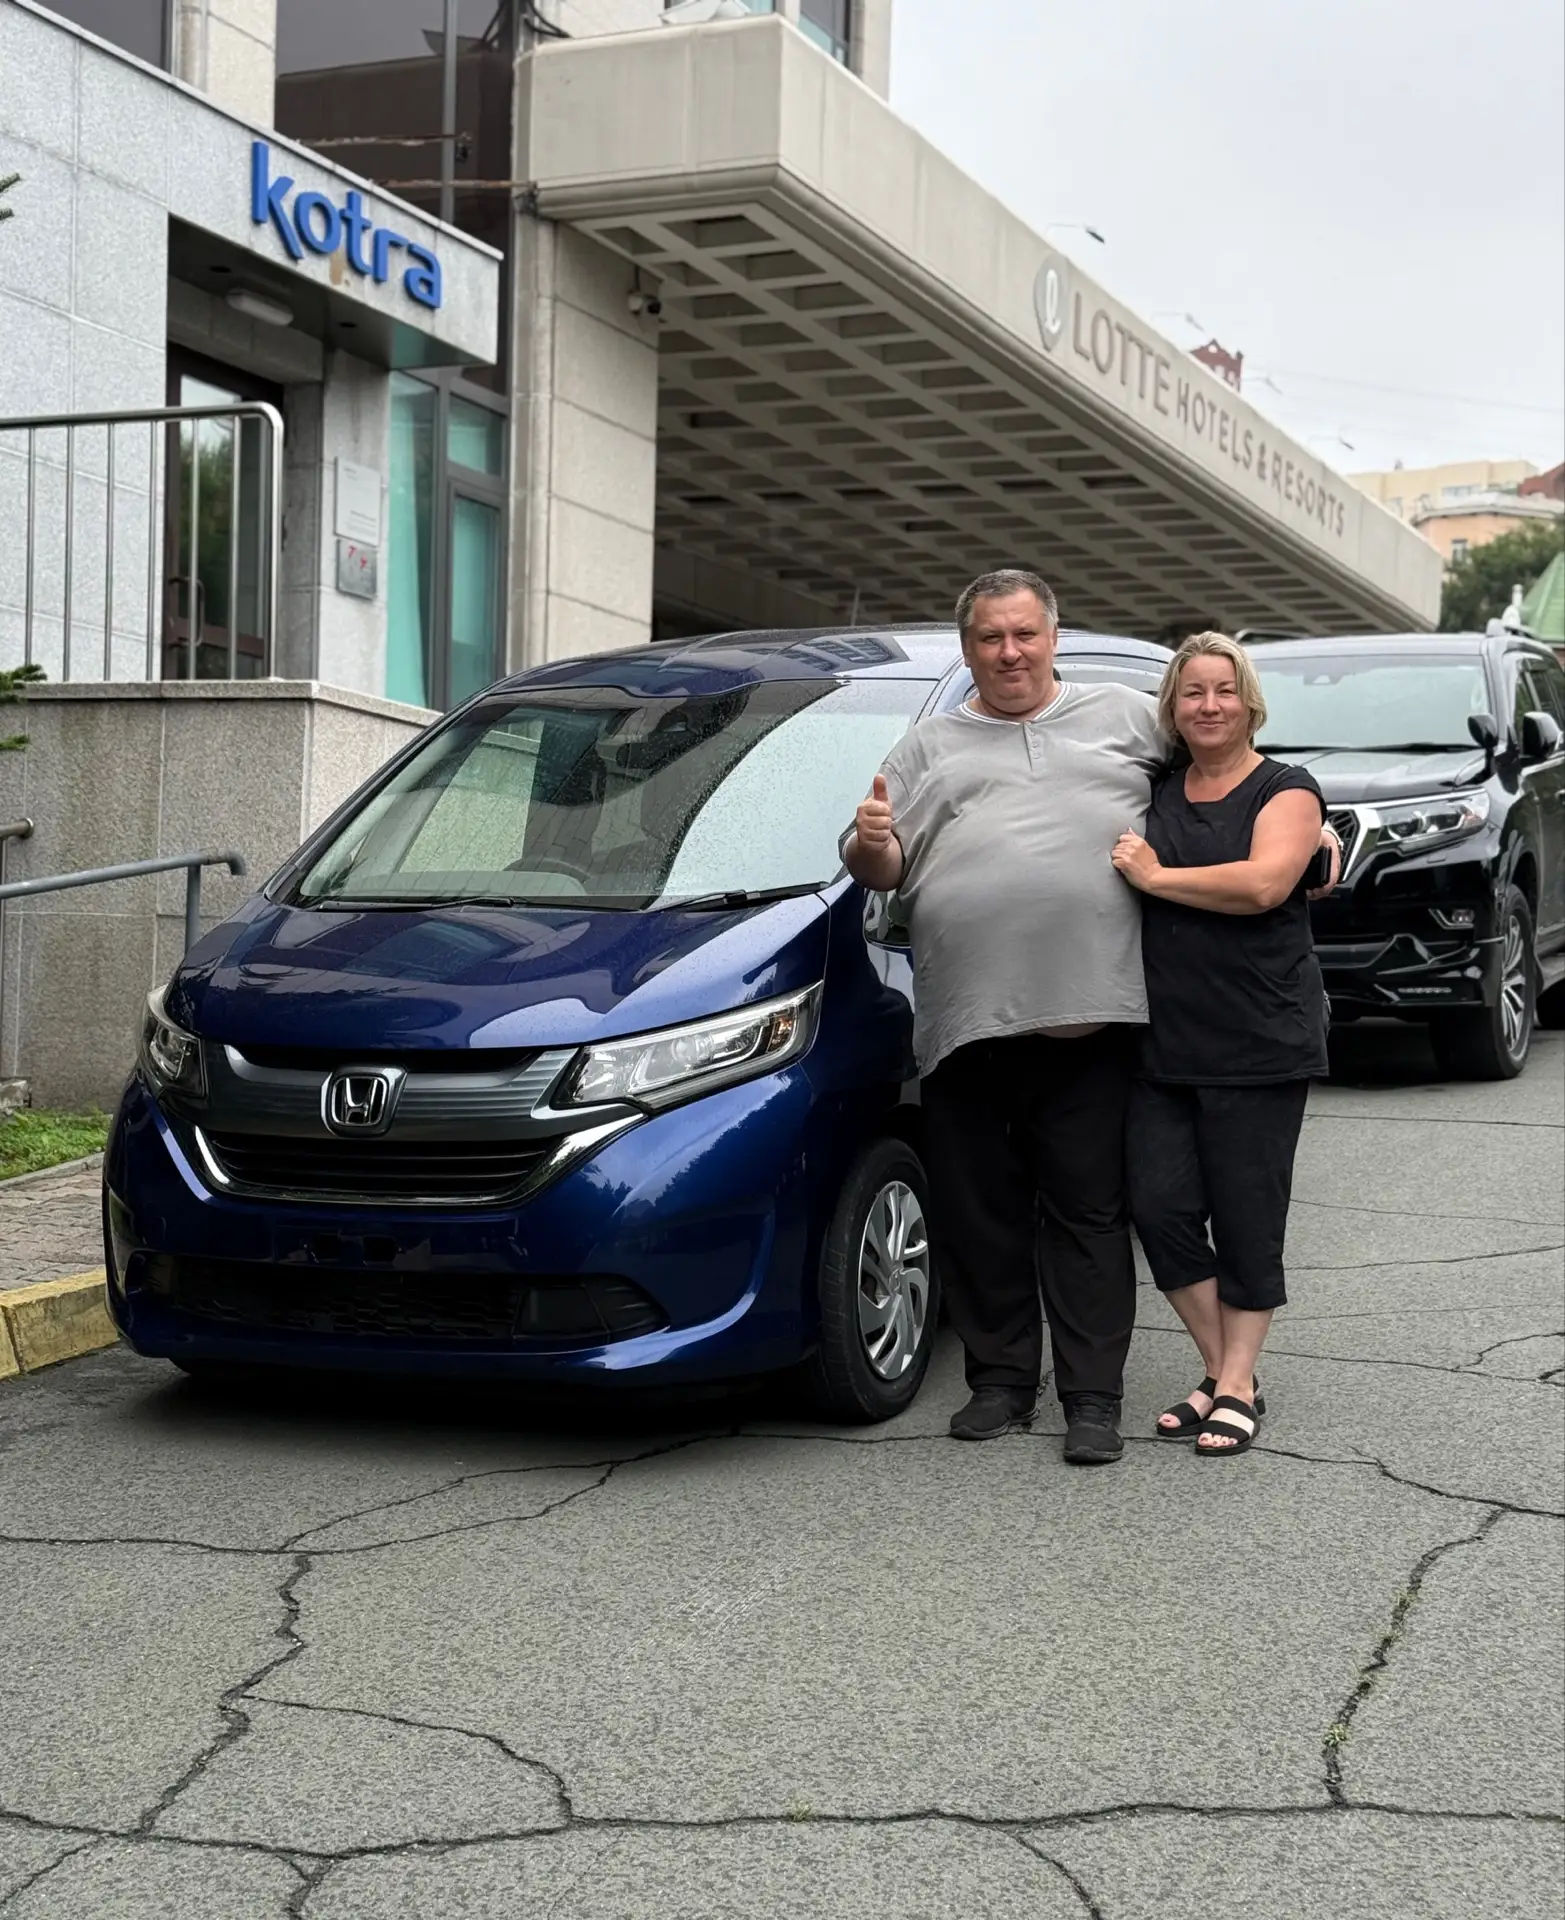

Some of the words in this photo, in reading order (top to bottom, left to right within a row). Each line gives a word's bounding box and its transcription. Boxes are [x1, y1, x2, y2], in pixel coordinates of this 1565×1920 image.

[252, 141, 441, 309] kotra
[1073, 291, 1171, 416] LOTTE
[1177, 377, 1253, 471] HOTELS
[1271, 451, 1345, 538] RESORTS
